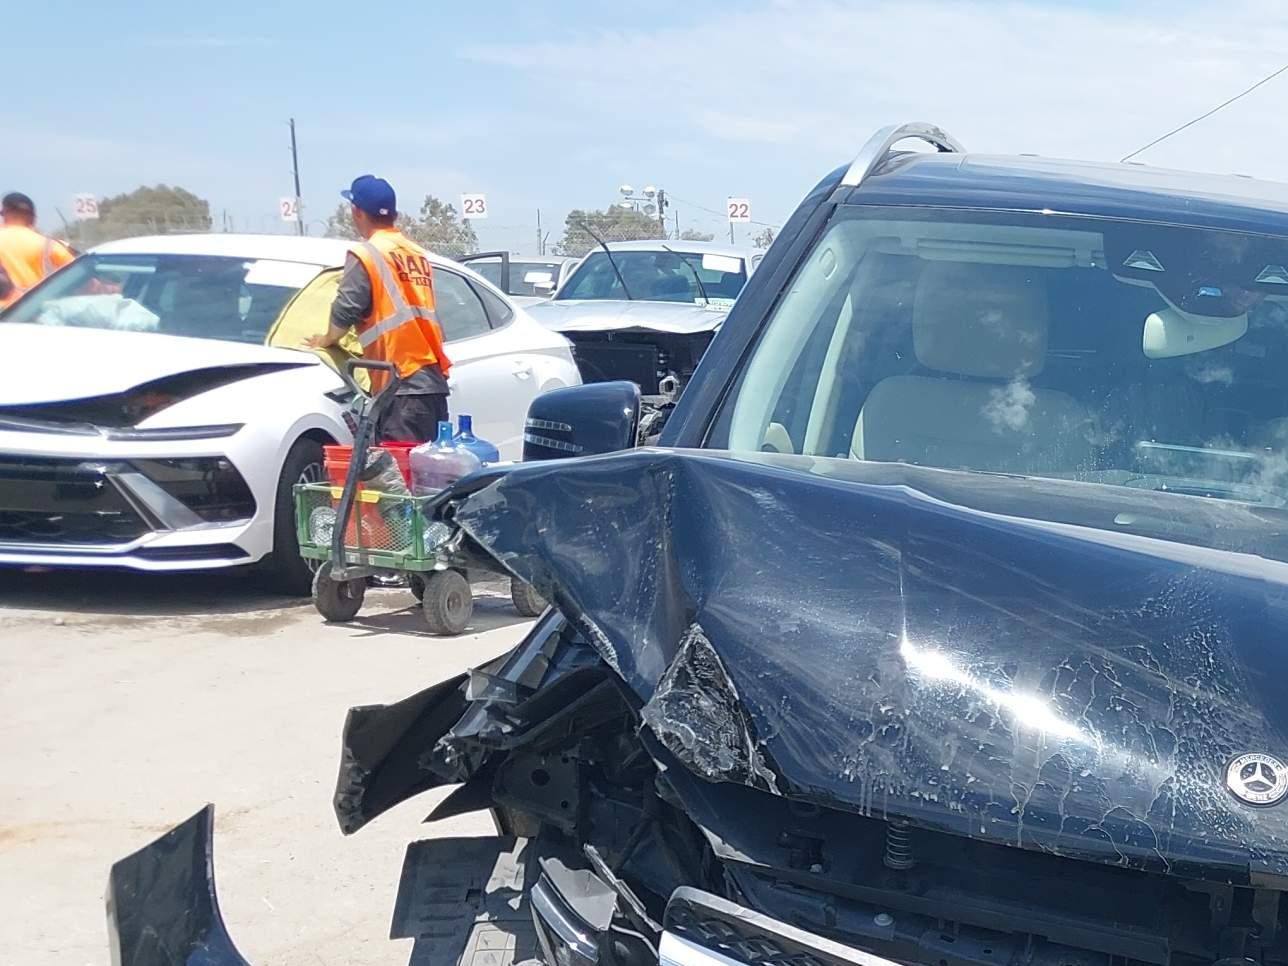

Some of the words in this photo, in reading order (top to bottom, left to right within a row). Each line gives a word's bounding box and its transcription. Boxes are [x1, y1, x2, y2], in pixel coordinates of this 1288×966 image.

[77, 198, 97, 213] 25
[464, 199, 485, 213] 23
[729, 203, 749, 218] 22
